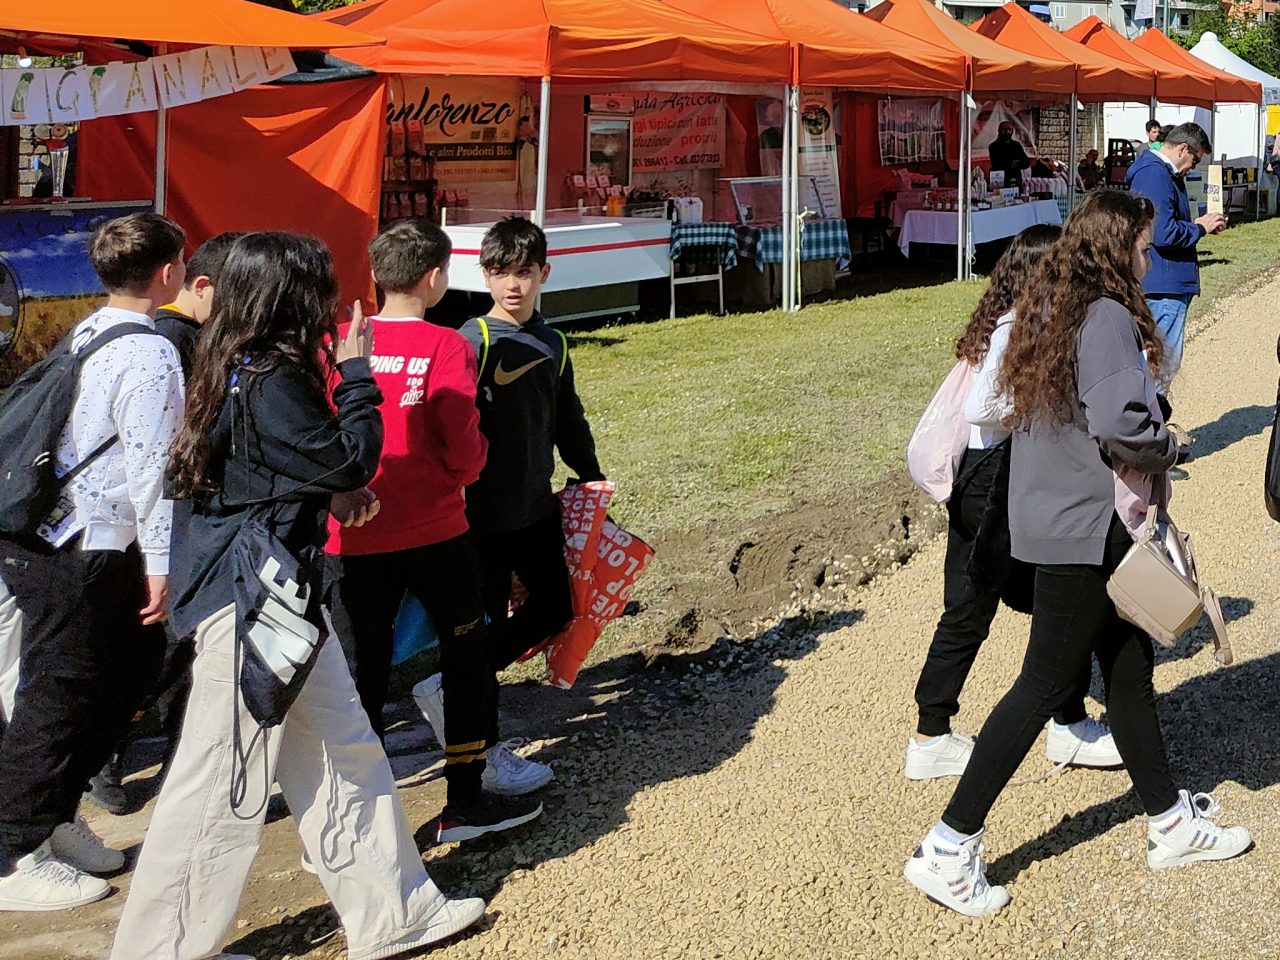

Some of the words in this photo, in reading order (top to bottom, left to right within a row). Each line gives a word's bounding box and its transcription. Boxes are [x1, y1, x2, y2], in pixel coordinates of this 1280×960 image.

[386, 86, 515, 137] anlorenzo
[437, 146, 455, 157] altri
[456, 145, 495, 157] Prodotti
[496, 145, 513, 156] Bio
[633, 136, 672, 148] duzione
[369, 355, 406, 374] PING
[406, 357, 431, 375] US
[248, 556, 320, 686] NIE
